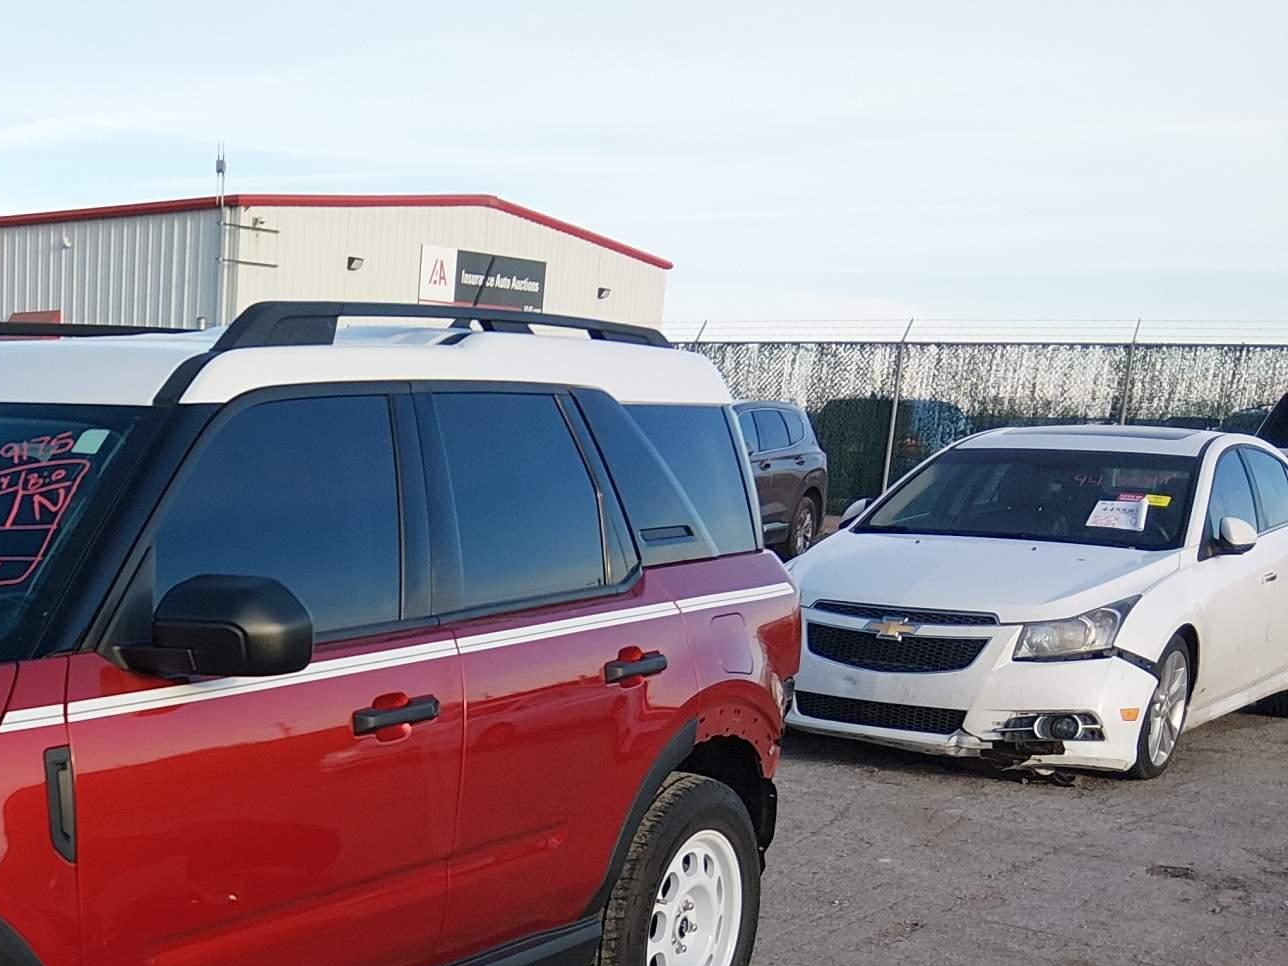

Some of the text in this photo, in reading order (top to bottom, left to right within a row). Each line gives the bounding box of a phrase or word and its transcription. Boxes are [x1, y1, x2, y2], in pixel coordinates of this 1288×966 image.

[460, 269, 540, 293] Insurace Auto Auctions
[33, 487, 65, 521] N
